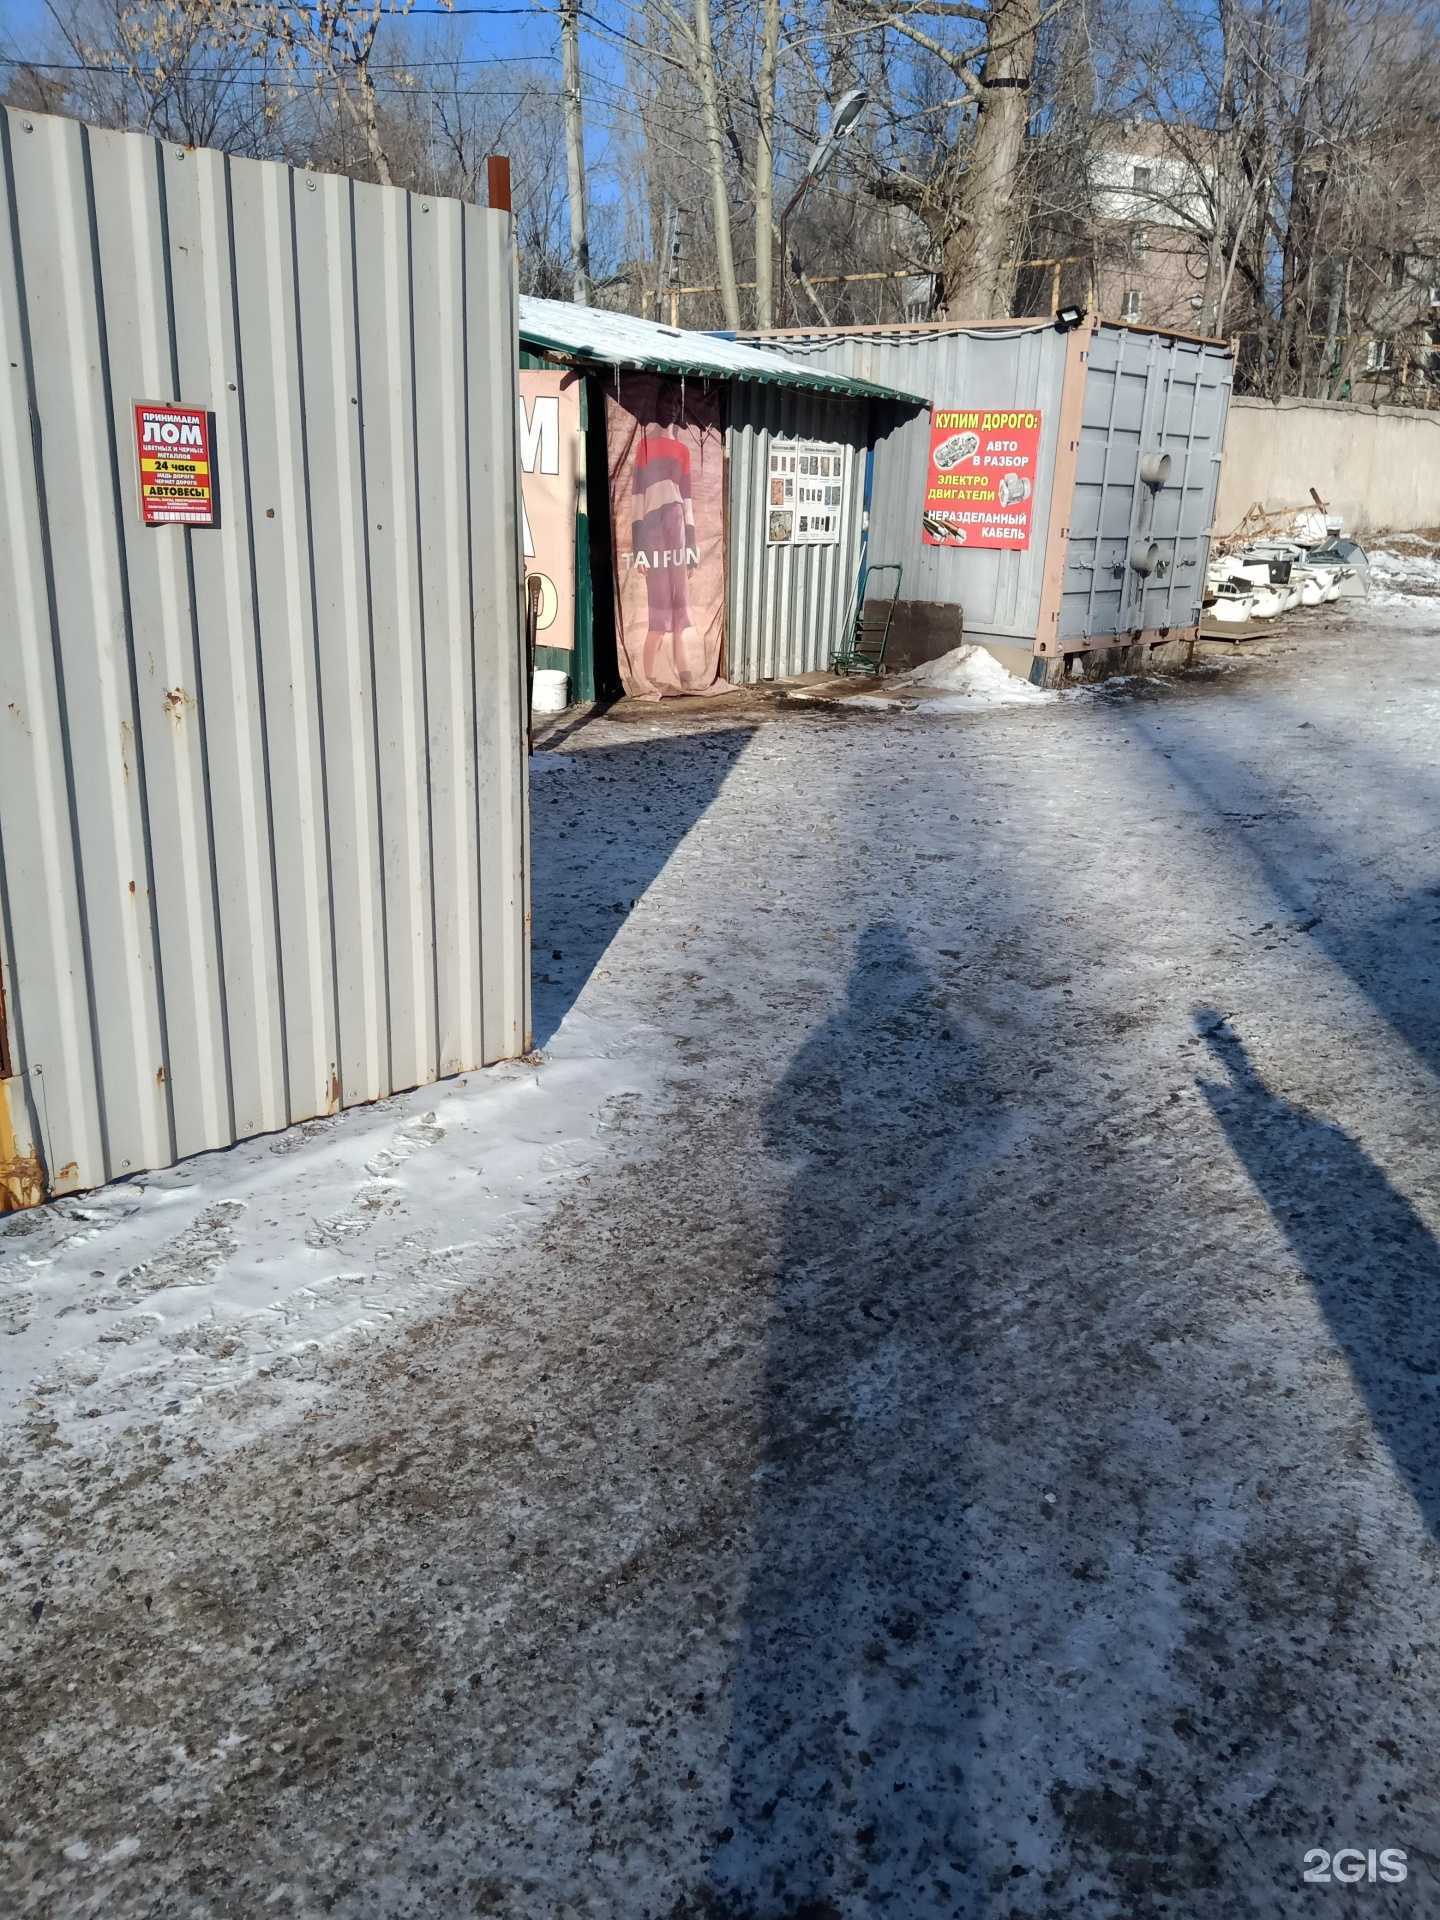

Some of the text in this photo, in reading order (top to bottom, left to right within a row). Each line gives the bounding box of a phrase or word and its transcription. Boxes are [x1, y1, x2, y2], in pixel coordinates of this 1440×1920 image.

[143, 413, 200, 425] ПРИНИМАЕМ
[936, 413, 1038, 431] КУПИМ ДОРОГО:
[143, 422, 203, 446] ЛОМ
[986, 440, 1018, 452] АВТО
[155, 461, 196, 472] 24 часа
[972, 456, 1029, 467] В РАЗБОР
[937, 475, 989, 486] ЭЛЕКТРО
[149, 487, 205, 497] АВТОВЕСЫ
[928, 488, 995, 501] ДВИГАТЕЛИ
[928, 510, 1027, 525] НЕРАЗДЕЛАННЫЙ
[981, 527, 1026, 540] КАБЕЛЬ
[622, 547, 701, 569] TAIFUN
